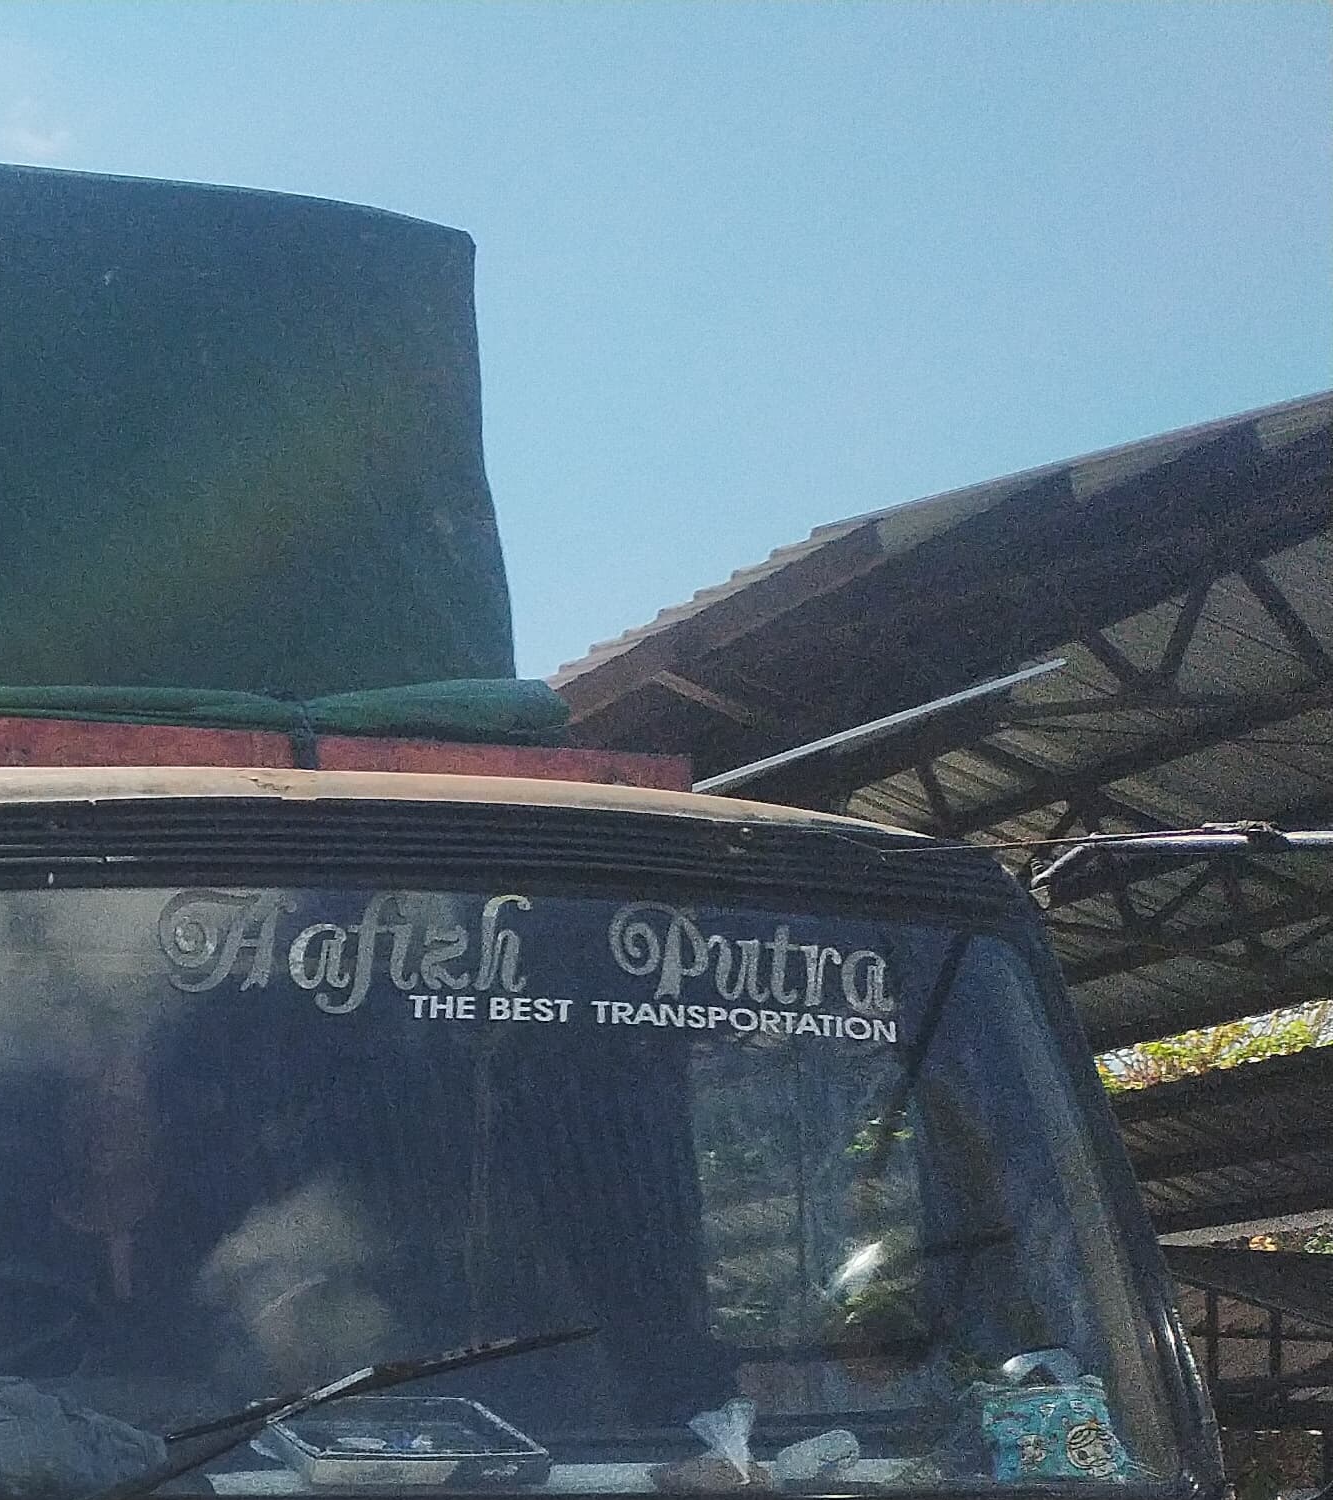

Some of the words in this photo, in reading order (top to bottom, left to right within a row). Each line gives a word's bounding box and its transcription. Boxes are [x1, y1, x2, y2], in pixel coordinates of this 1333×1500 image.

[607, 899, 895, 1013] Putra
[408, 994, 475, 1021] THE
[488, 996, 573, 1024] BEST
[592, 1000, 898, 1043] TRANSPORTATION
